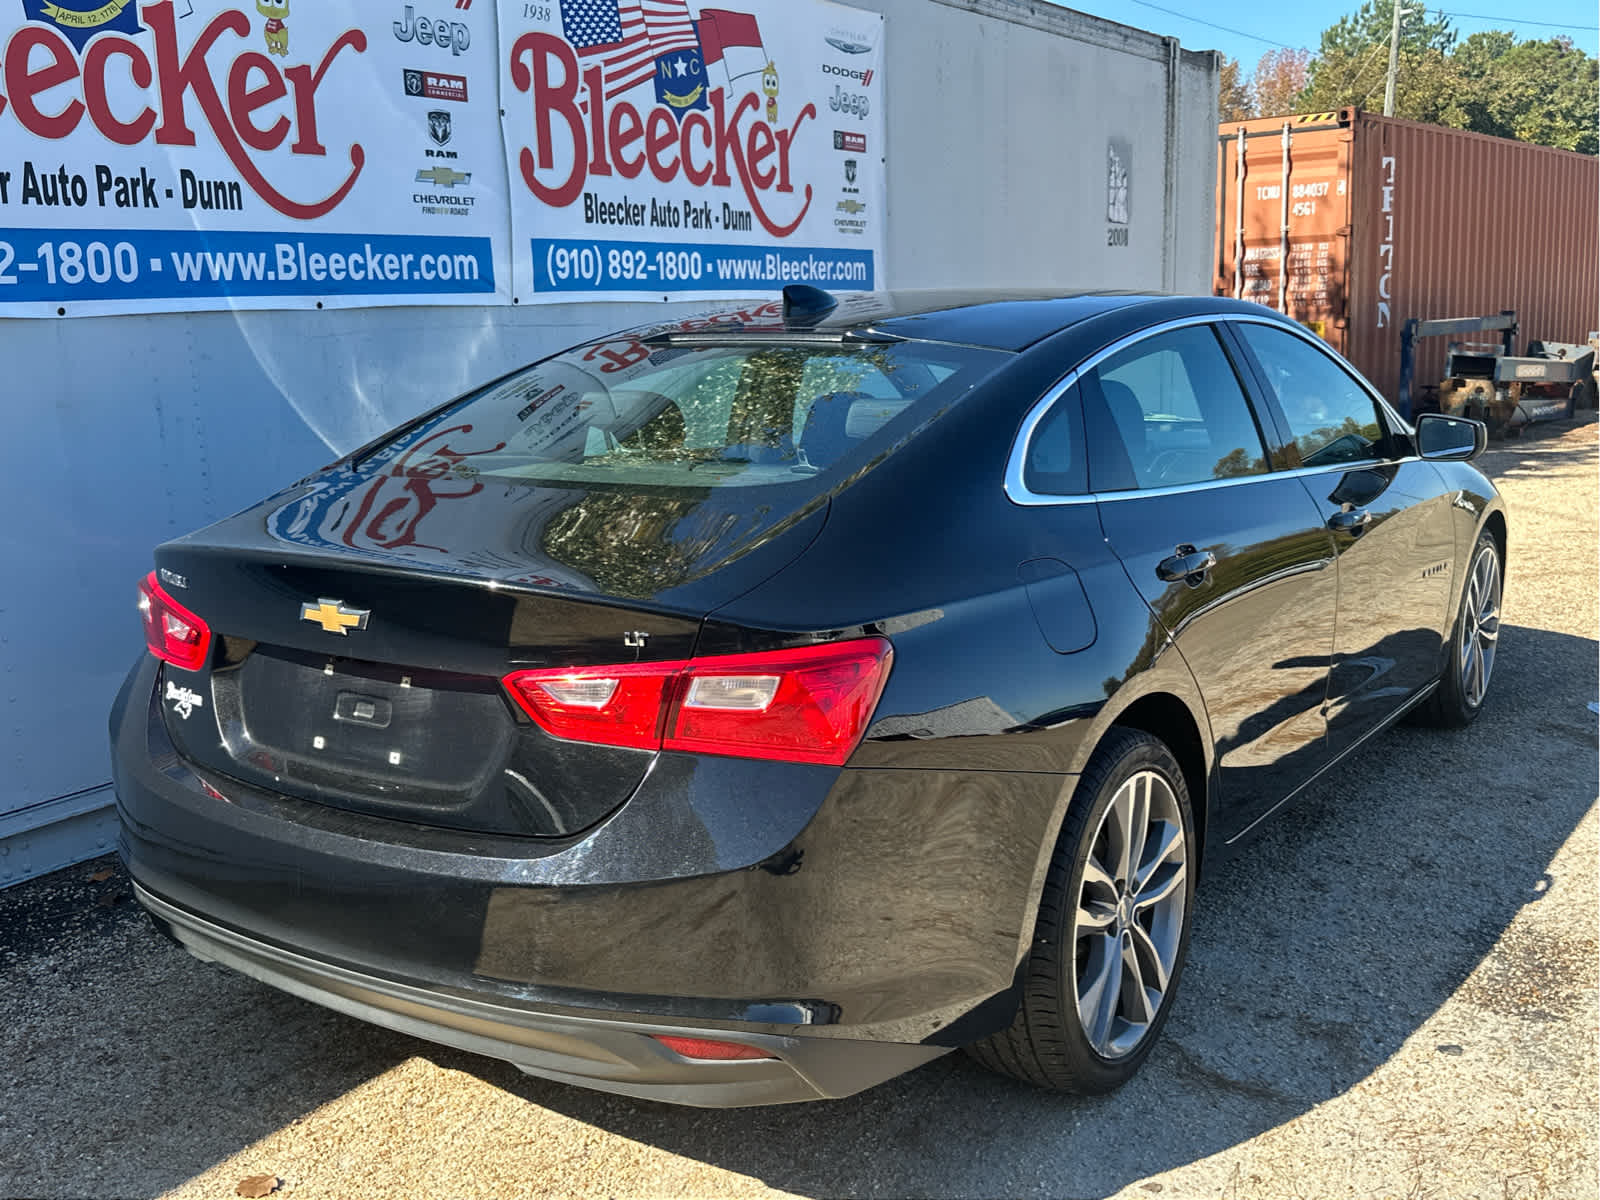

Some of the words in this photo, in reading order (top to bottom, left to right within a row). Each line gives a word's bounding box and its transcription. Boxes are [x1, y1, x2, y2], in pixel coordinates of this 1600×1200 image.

[58, 11, 86, 25] APRIL
[100, 4, 118, 20] 1776
[523, 3, 551, 22] 1938
[392, 5, 471, 56] Jeep
[427, 76, 464, 89] RAM
[660, 61, 672, 80] N
[689, 57, 701, 76] C
[822, 64, 866, 81] DODGE
[0, 0, 368, 220] ecker
[828, 85, 870, 121] Jeep
[510, 31, 816, 238] Bleecker
[424, 149, 458, 160] RAM
[22, 161, 88, 207] Auto
[95, 165, 159, 208] Park
[180, 169, 243, 210] Dunn
[412, 193, 476, 207] CHEVROLET
[584, 192, 647, 227] Bleecker
[650, 198, 680, 229] Auto
[684, 200, 713, 230] Park
[722, 202, 752, 231] Dunn
[171, 242, 479, 282] www.Bleecker.com
[547, 244, 602, 286] (910)
[608, 250, 702, 282] 892-1800
[717, 254, 867, 283] www.Bleecker.com
[624, 630, 649, 648] LT
